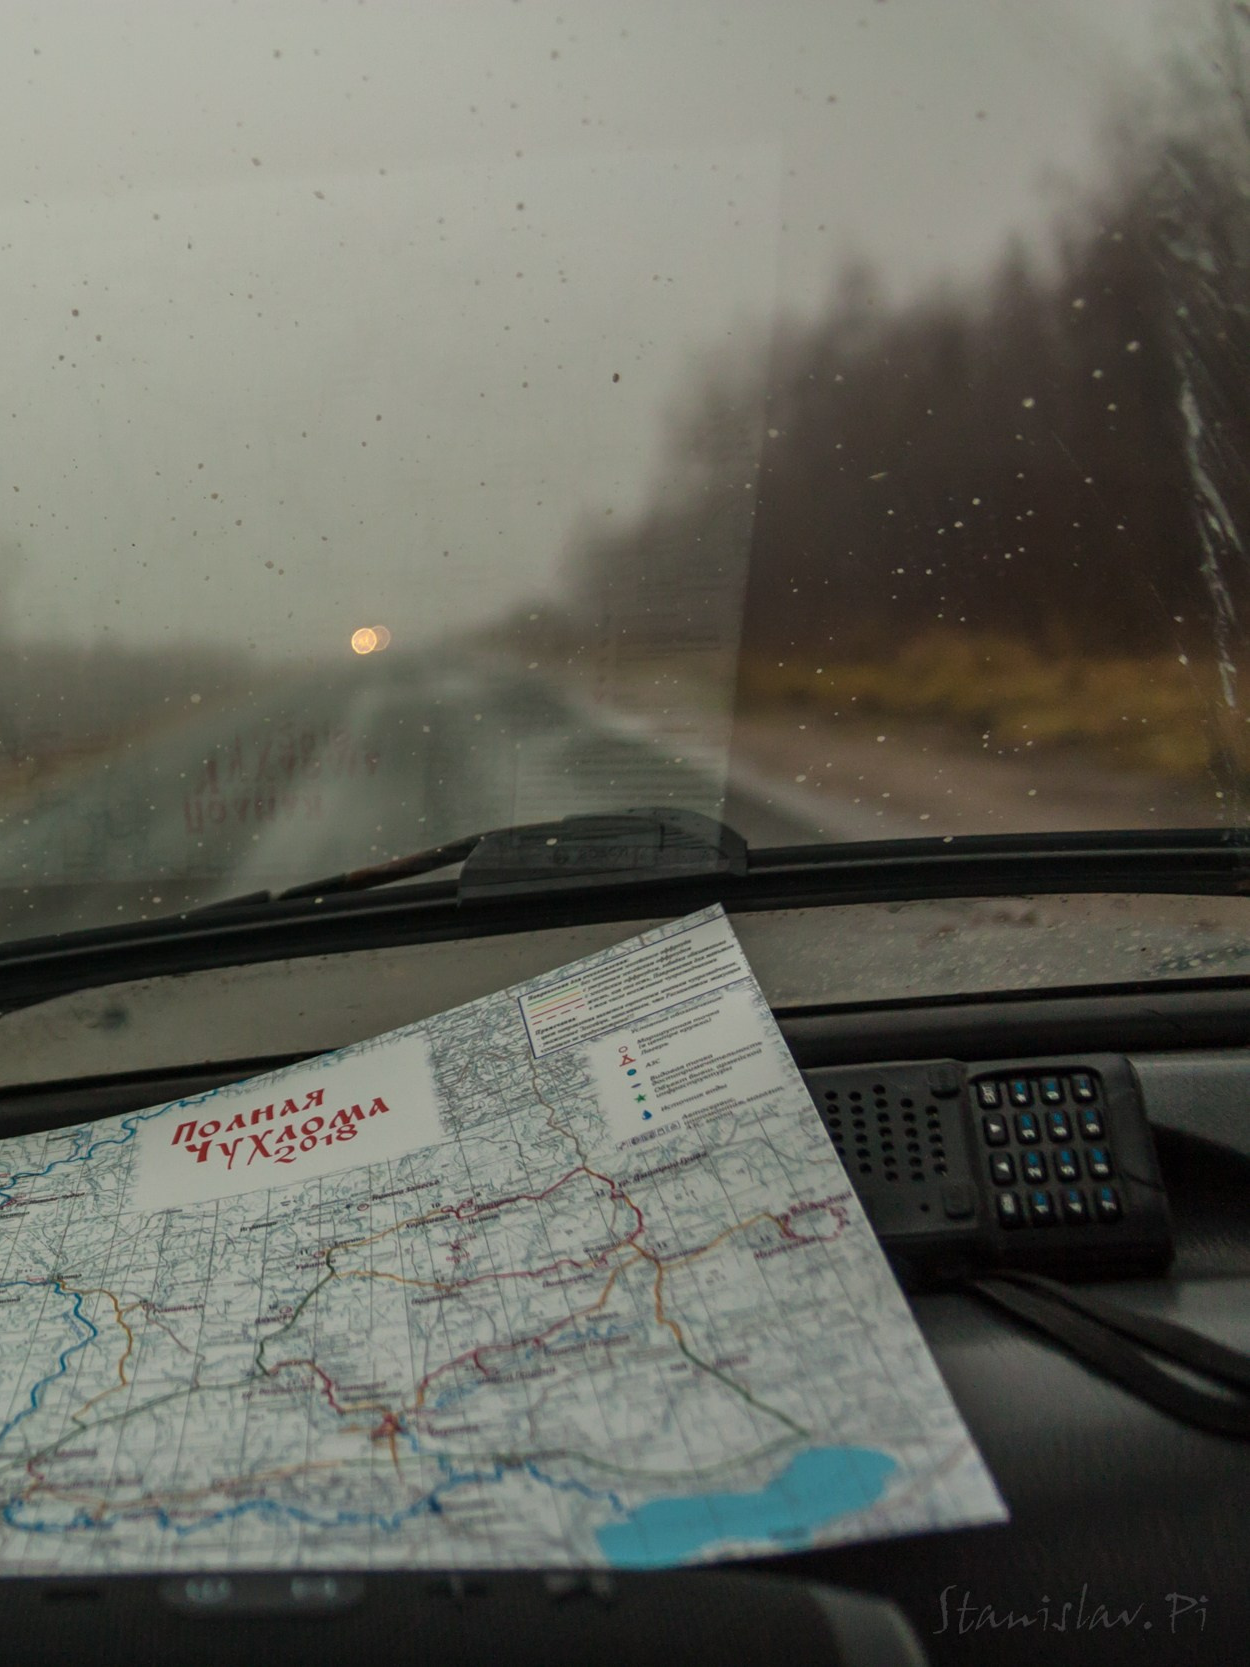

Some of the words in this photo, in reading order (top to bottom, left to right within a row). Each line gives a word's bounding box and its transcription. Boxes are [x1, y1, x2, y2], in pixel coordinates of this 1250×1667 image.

[171, 1088, 325, 1145] ПОЛНАЯ
[185, 1097, 390, 1170] ЧУХЛОМА
[274, 1123, 359, 1163] 2018
